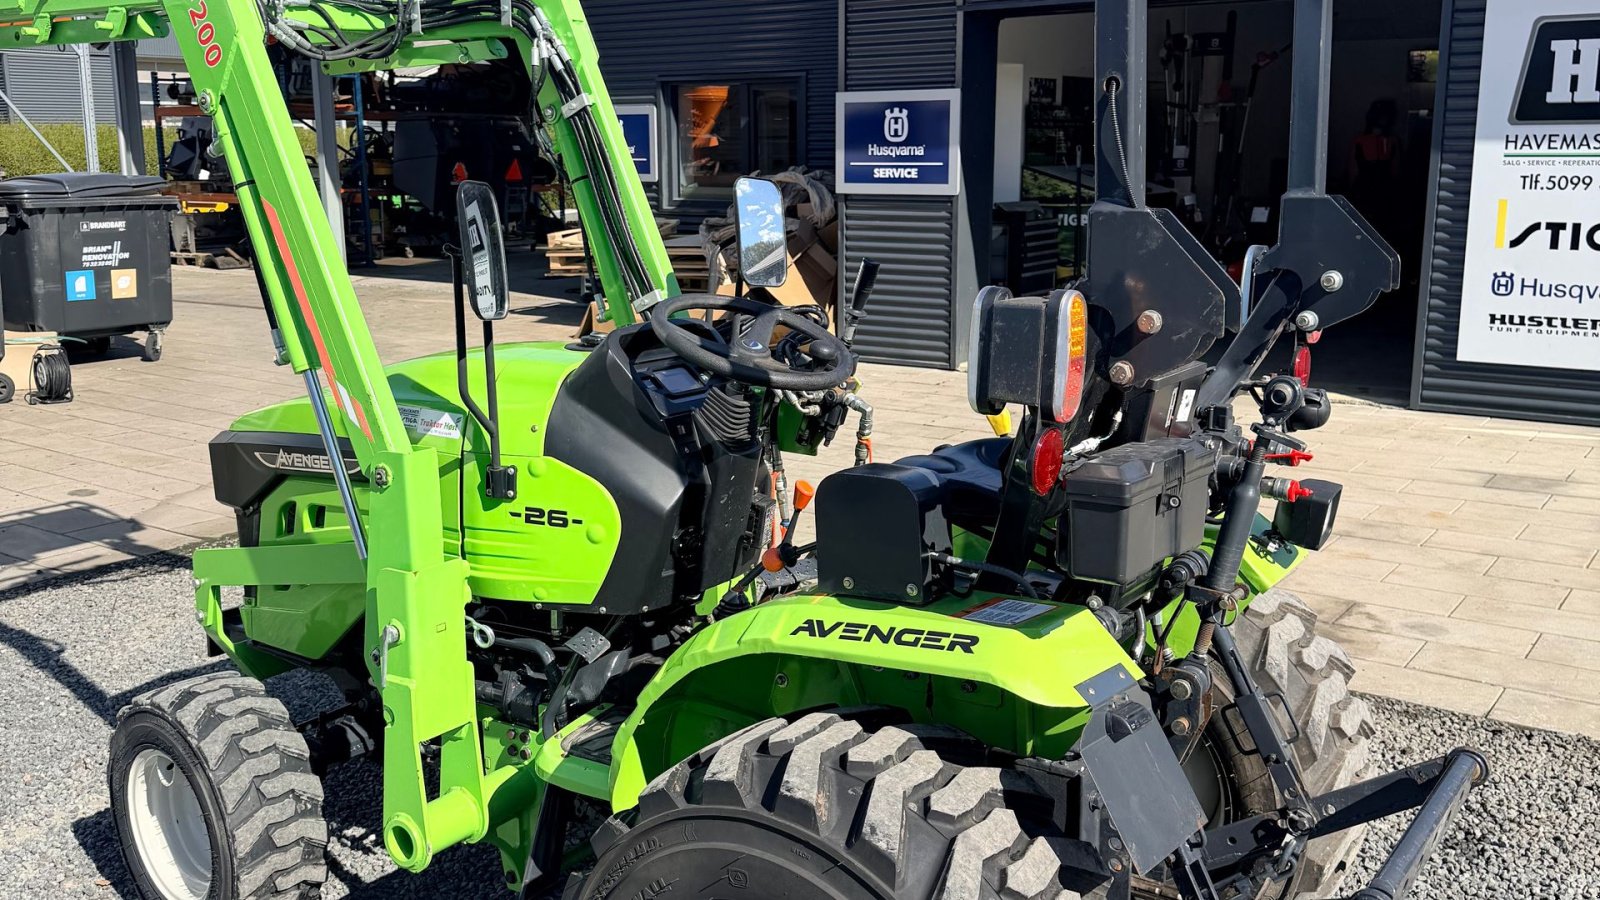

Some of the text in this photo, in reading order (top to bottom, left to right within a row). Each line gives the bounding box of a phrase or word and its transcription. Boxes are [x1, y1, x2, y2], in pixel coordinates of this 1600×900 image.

[868, 144, 925, 158] Husqvarna
[873, 168, 918, 178] SERVICE
[1520, 173, 1593, 191] Tlf.5099
[1520, 277, 1600, 304] Husqv
[276, 448, 334, 469] AVENGE
[789, 619, 980, 654] AVENGER
